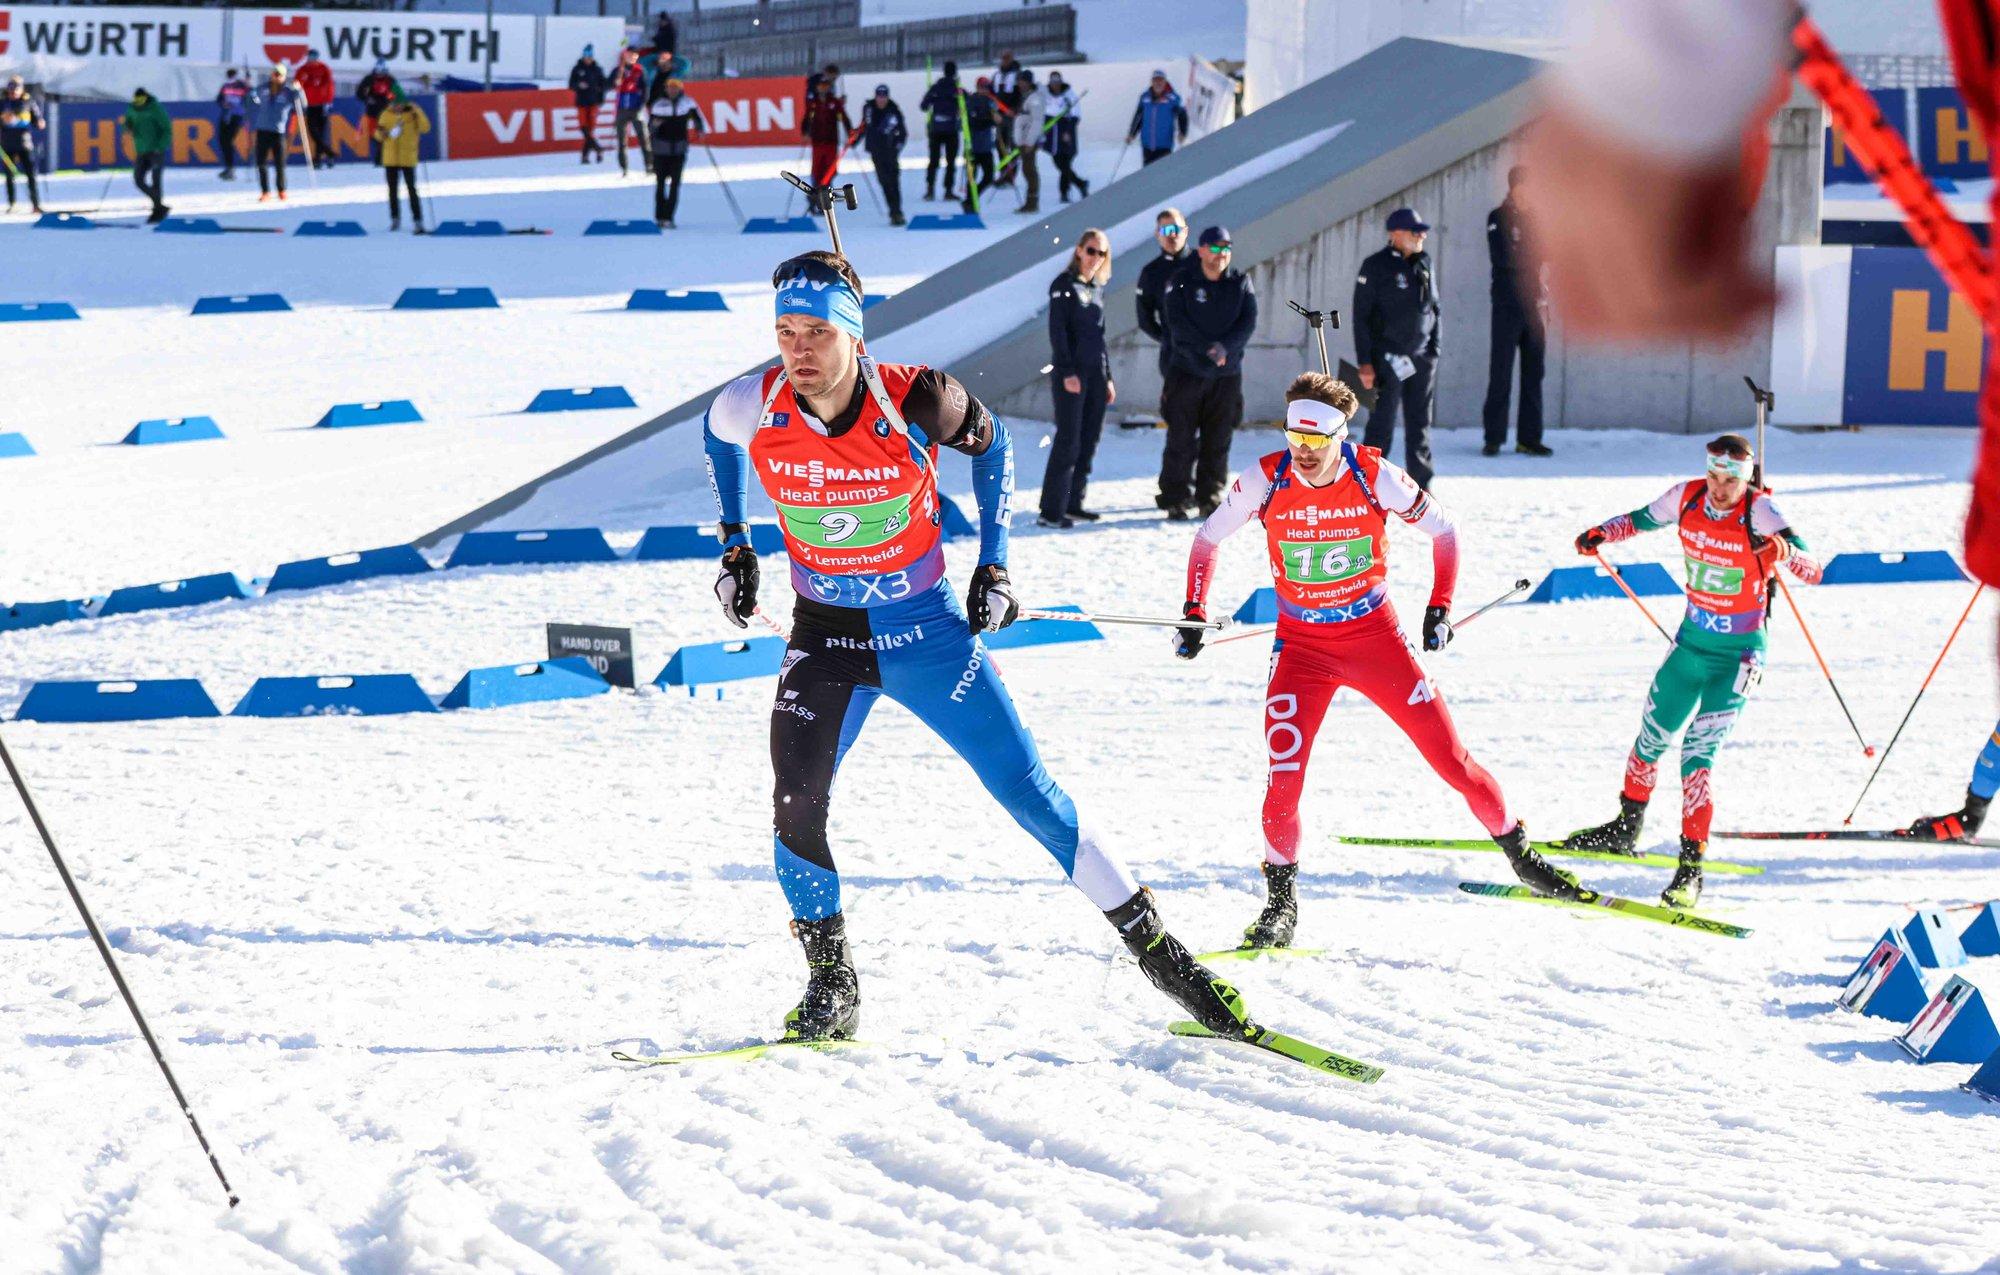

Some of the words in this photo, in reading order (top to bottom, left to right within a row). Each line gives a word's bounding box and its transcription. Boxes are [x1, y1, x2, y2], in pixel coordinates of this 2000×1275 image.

[24, 22, 188, 57] WÜRTH
[324, 26, 498, 63] WÜRTH
[767, 459, 900, 488] VIESSMANN
[780, 487, 819, 502] Heat
[825, 485, 889, 504] pumps
[818, 511, 860, 543] 9
[882, 515, 901, 535] 2
[1287, 529, 1315, 539] Heat
[1319, 527, 1361, 540] pumps
[1680, 530, 1744, 552] VIESSMANN
[815, 544, 904, 566] Lenzerheide
[1292, 545, 1351, 578] 16
[856, 570, 912, 604] X3
[1307, 579, 1367, 599] Lenzerheide
[1704, 612, 1733, 633] X3
[561, 636, 592, 650] HAND
[592, 639, 621, 652] OVER
[586, 655, 609, 674] ND
[1319, 1055, 1370, 1078] FISCHER
